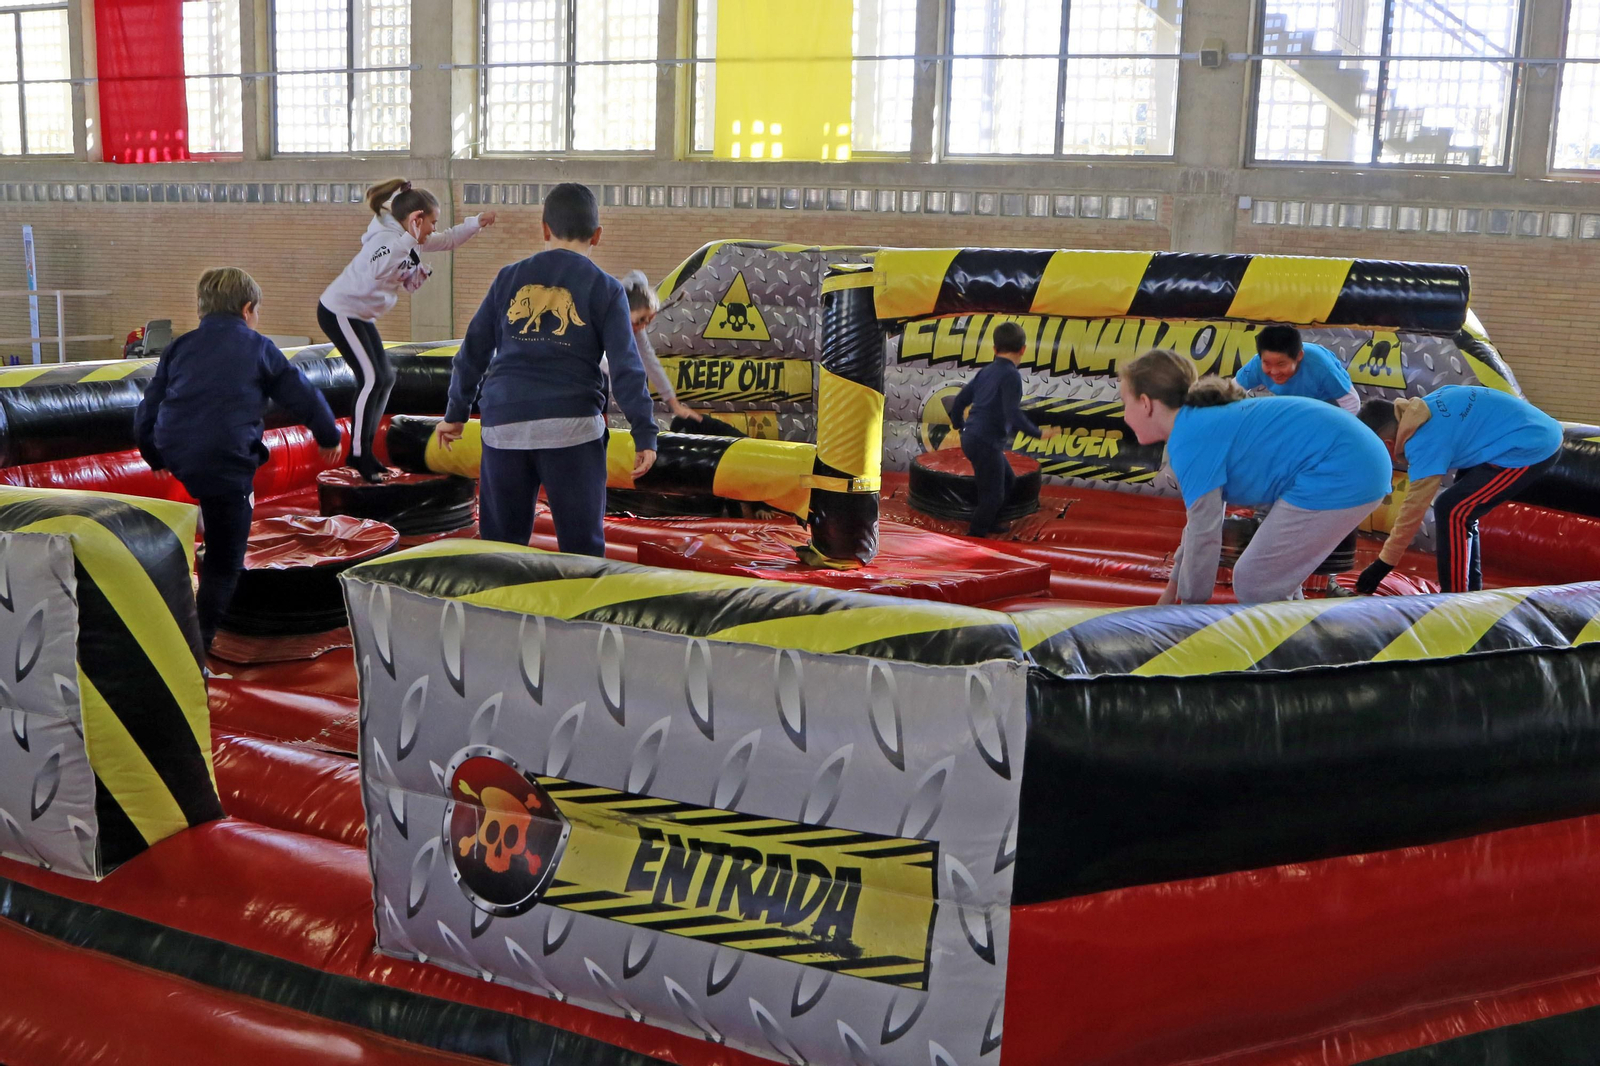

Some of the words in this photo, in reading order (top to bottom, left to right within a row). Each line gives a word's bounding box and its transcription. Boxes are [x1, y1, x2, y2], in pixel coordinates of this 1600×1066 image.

[676, 359, 735, 391] KEEP
[738, 359, 785, 392] OUT
[1011, 424, 1124, 459] DANGER
[624, 827, 862, 942] ENTRADA
